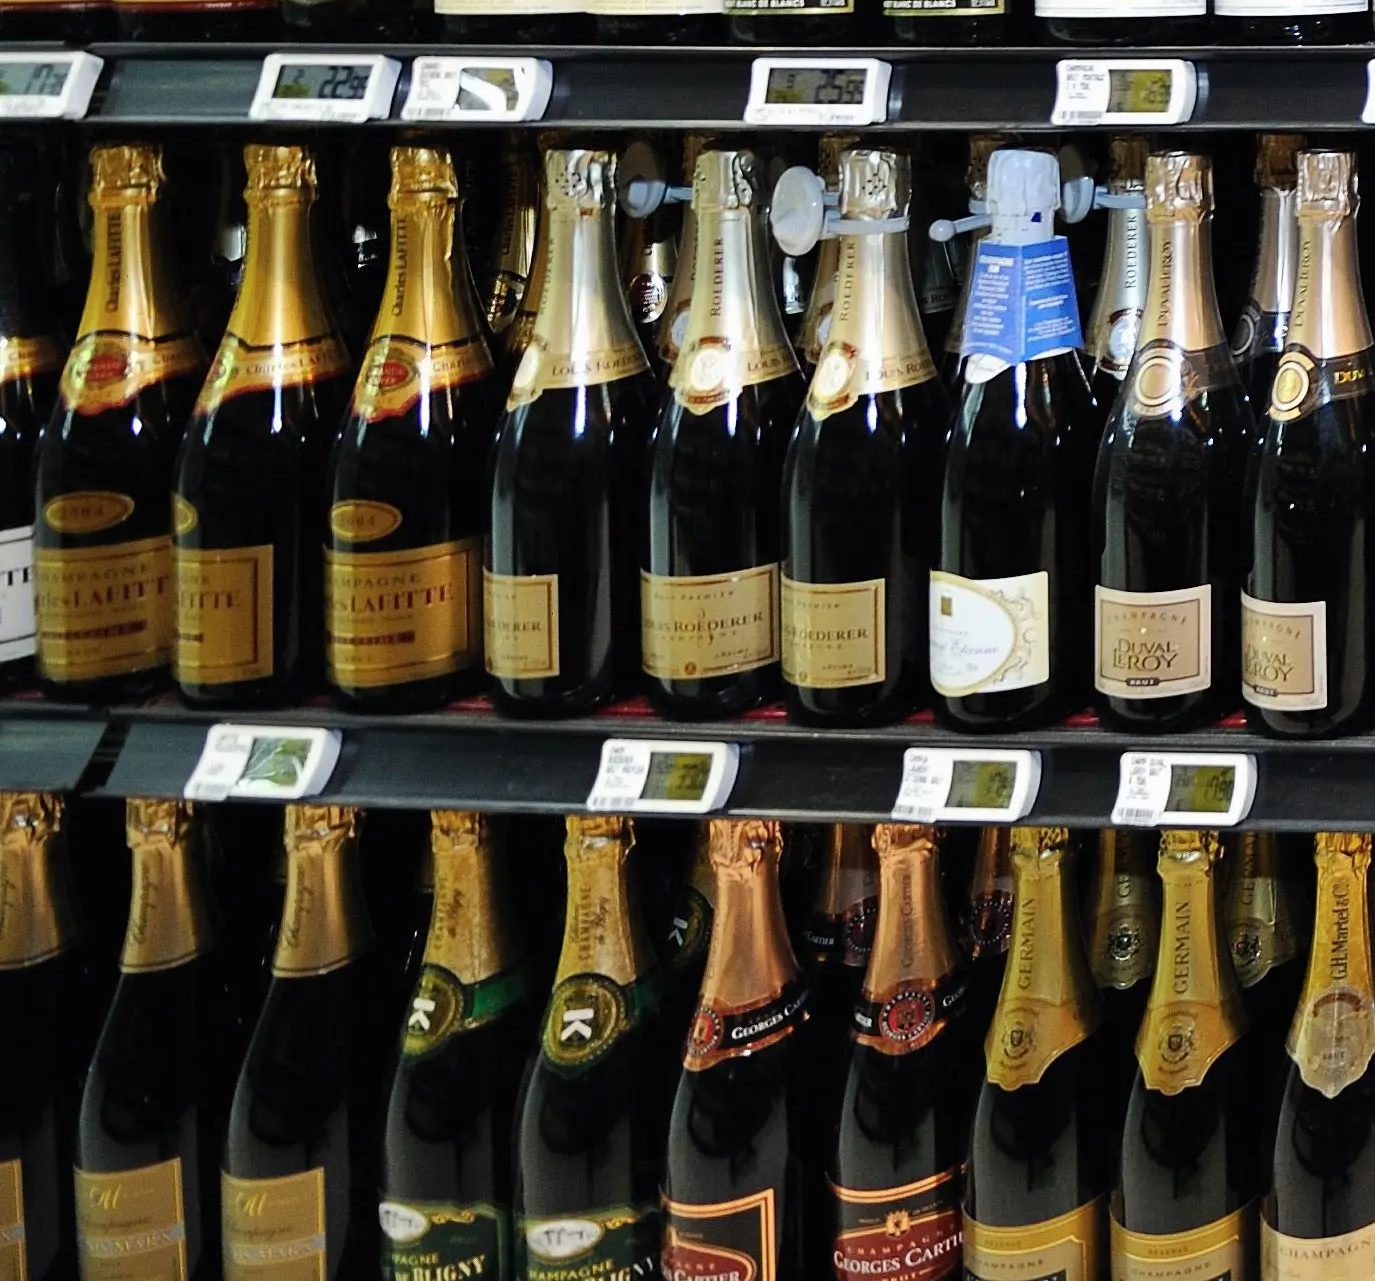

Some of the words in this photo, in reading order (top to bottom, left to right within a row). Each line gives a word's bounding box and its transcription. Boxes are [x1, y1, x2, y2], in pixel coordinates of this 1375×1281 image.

[1112, 646, 1178, 671] LEROY
[1118, 638, 1177, 654] DUVAL
[1017, 896, 1033, 990] GERMAIN
